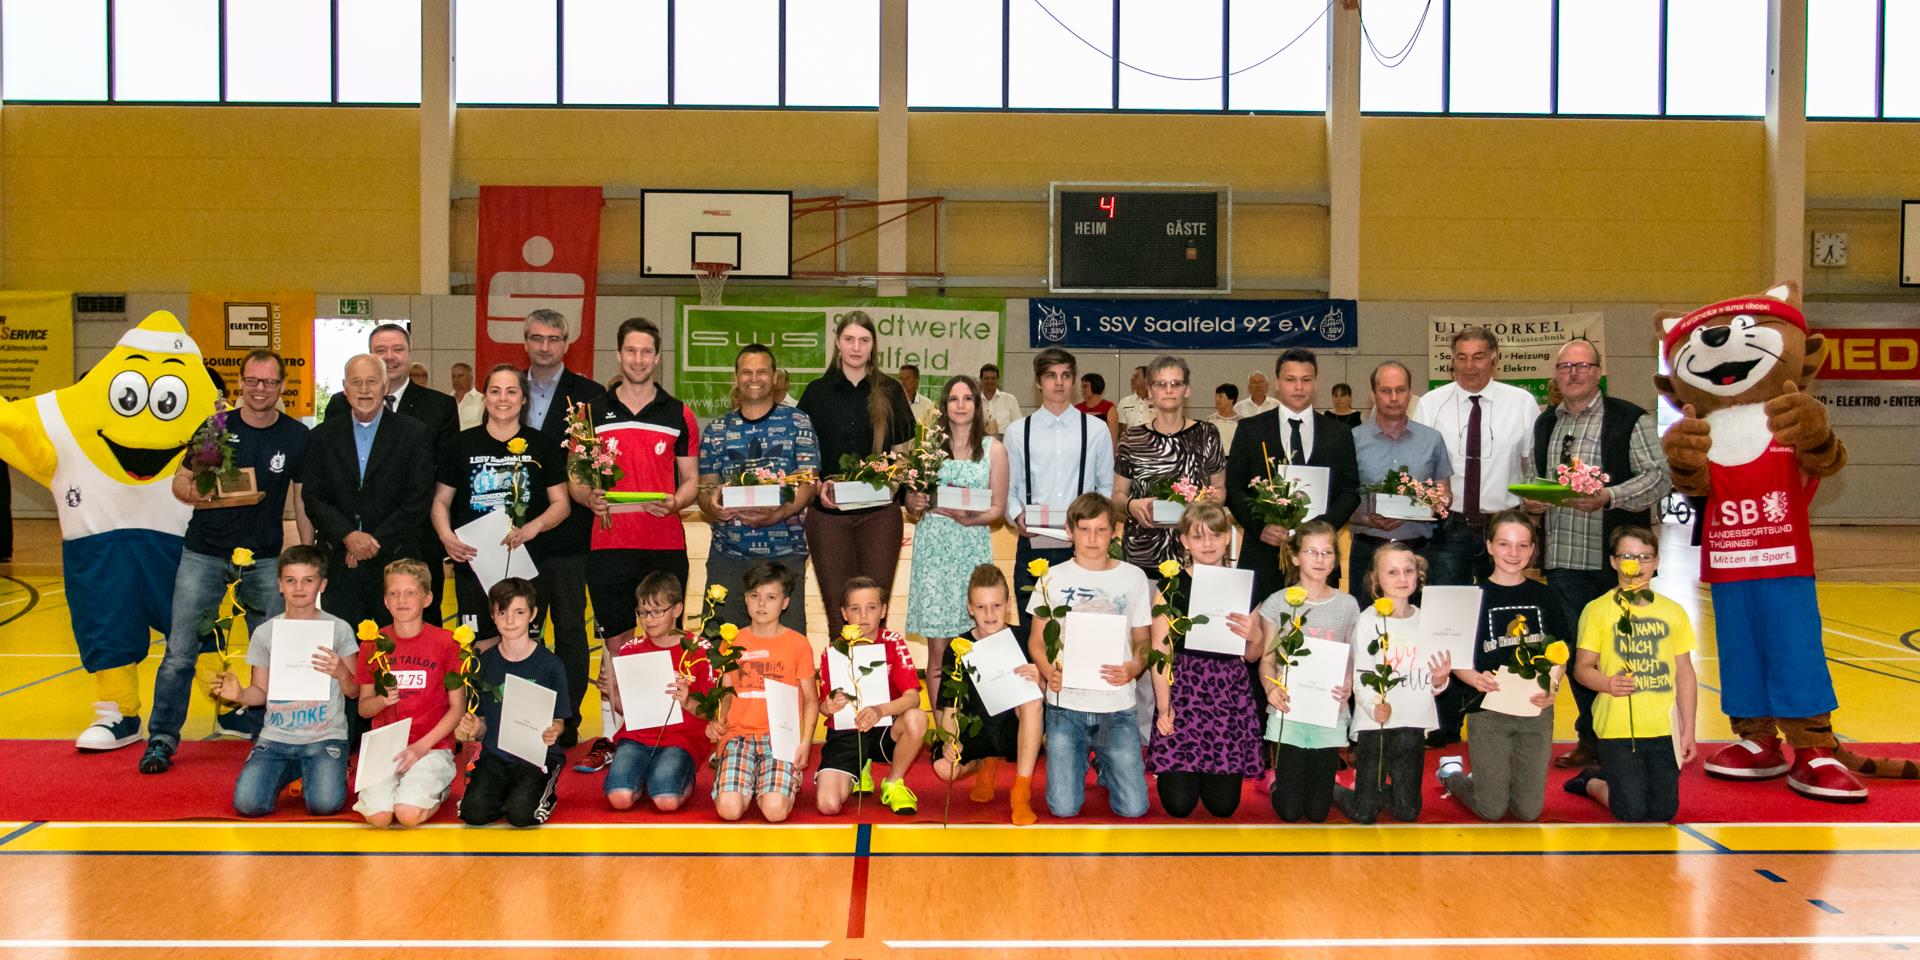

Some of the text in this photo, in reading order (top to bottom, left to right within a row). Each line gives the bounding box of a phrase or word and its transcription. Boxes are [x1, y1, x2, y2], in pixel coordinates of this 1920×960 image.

[1099, 196, 1115, 218] 4
[1074, 222, 1107, 235] HEIM
[1166, 219, 1207, 236] GÄSTE
[229, 323, 268, 331] ELEKTRO
[1099, 316, 1137, 332] SSV
[1144, 315, 1237, 334] Saalfeld
[1243, 316, 1271, 332] 92
[1278, 315, 1317, 332] e.V.
[691, 331, 819, 348] SWS
[1507, 334, 1566, 344] Haustechnik
[203, 358, 243, 367] GOLLNIC
[1510, 352, 1550, 361] Heizung
[1503, 364, 1537, 373] Elektro
[1836, 395, 1881, 407] ELEKTRO
[1709, 523, 1793, 539] LANDESSPORTBUND
[1709, 539, 1758, 549] THÜRINGEN
[1712, 554, 1746, 564] Mitten
[1749, 554, 1759, 562] im
[1635, 621, 1666, 637] KANN
[400, 655, 437, 671] TAILOR
[288, 703, 328, 728] JOKE
